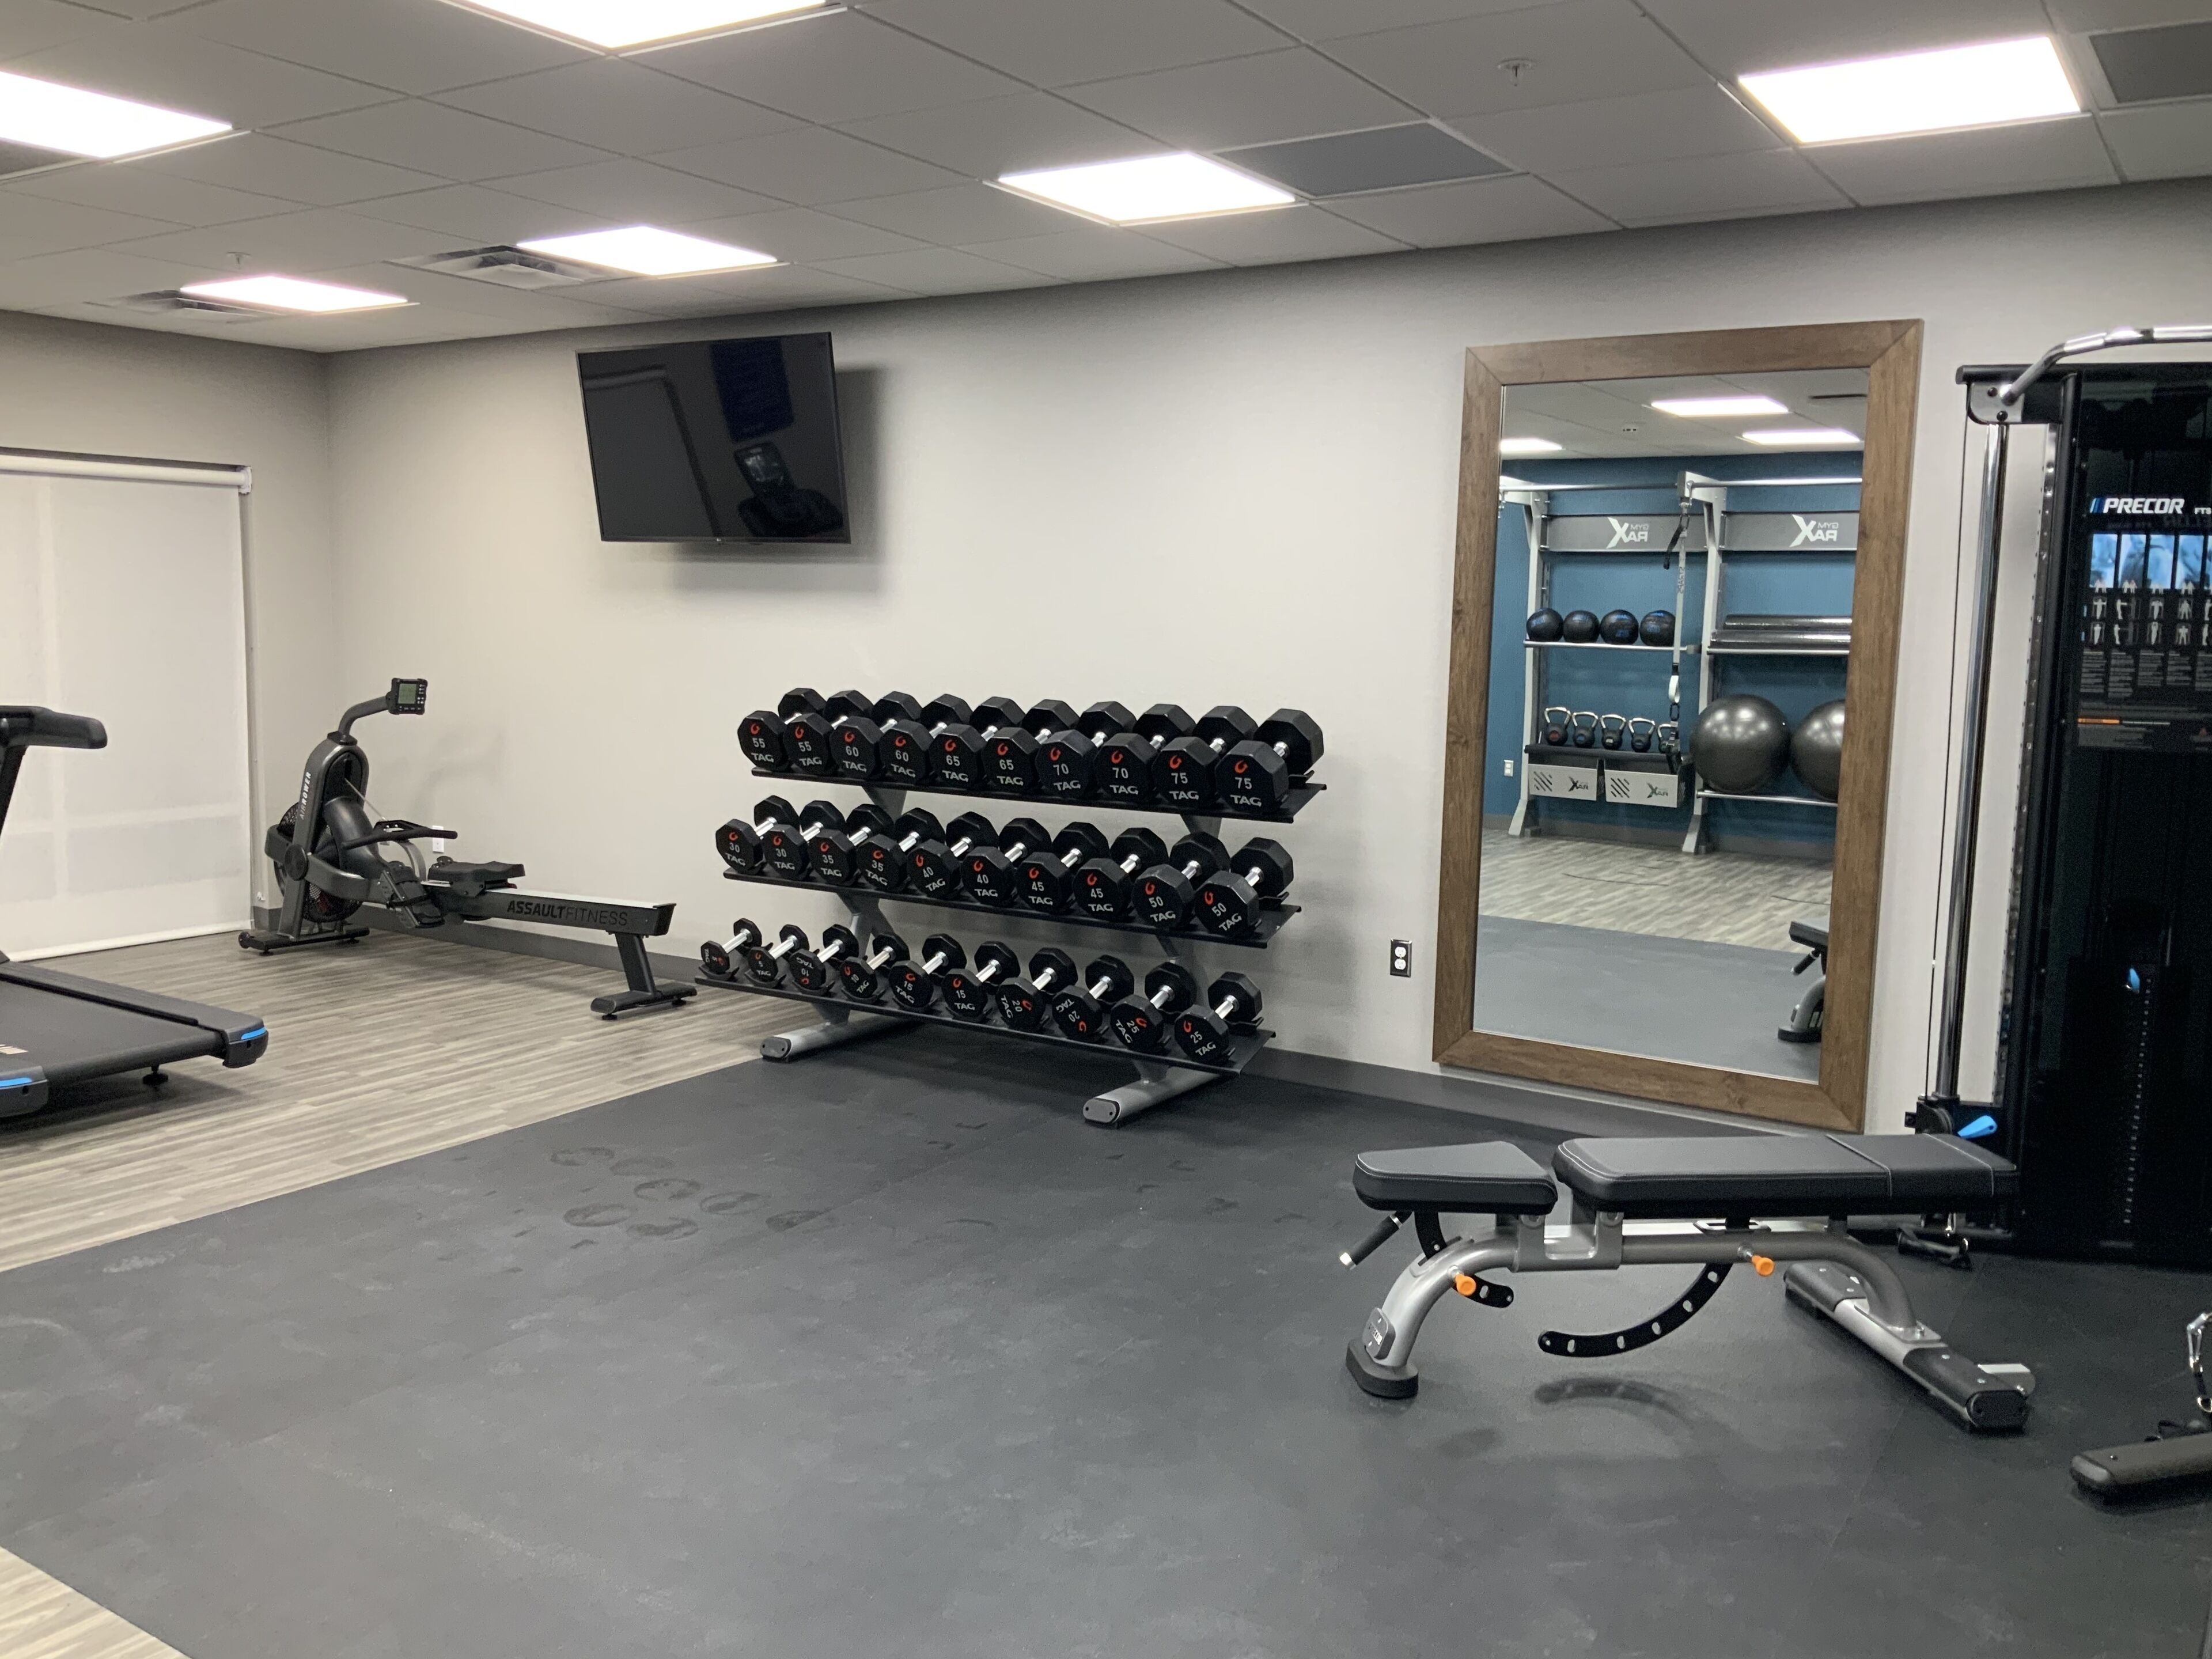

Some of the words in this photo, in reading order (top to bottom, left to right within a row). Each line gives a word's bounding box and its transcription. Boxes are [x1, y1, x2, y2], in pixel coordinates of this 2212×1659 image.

[2103, 498, 2185, 514] PRECOR
[752, 738, 766, 748] 55
[798, 741, 812, 752] 55
[846, 746, 858, 757] 60
[895, 750, 908, 762] 60
[751, 753, 774, 762] TAG
[799, 757, 822, 766] TAG
[946, 755, 960, 766] 65
[843, 760, 867, 772] TAG
[999, 759, 1014, 770] 65
[1053, 764, 1069, 775] 70
[891, 764, 916, 777] TAG
[942, 770, 969, 782] TAG
[1112, 768, 1128, 779] 70
[997, 776, 1024, 786] TAG
[1171, 772, 1188, 784] 75
[1235, 778, 1252, 789] 75
[1054, 781, 1081, 791] TAG
[1110, 785, 1138, 795] TAG
[1169, 791, 1199, 800] TAG
[1230, 795, 1262, 806] TAG
[729, 842, 740, 853] 30
[776, 849, 786, 857] 30
[725, 853, 746, 866] TAG
[822, 855, 834, 863] 35
[774, 862, 796, 870] TAG
[872, 860, 884, 872] 35
[821, 868, 842, 877] TAG
[866, 869, 888, 886] TAG
[923, 866, 934, 878] 40
[977, 874, 988, 884] 40
[926, 878, 946, 892] TAG
[1032, 881, 1044, 891] 45
[975, 889, 998, 897] TAG
[1090, 888, 1103, 898] 45
[1028, 896, 1053, 905] TAG
[1149, 896, 1163, 908] 50
[1088, 904, 1113, 912] TAG
[1212, 903, 1226, 916] 50
[1150, 911, 1176, 922] TAG
[1219, 913, 1242, 931] TAG
[796, 957, 813, 968] TAG
[857, 980, 869, 993] TAG
[904, 981, 913, 990] 15
[895, 986, 915, 1003] TAG
[956, 990, 966, 999] 15
[1001, 995, 1013, 1018] TAG
[1012, 1000, 1022, 1012] 20
[1056, 999, 1074, 1012] TAG
[1069, 1011, 1080, 1022] 20
[1115, 1020, 1132, 1043] TAG
[1127, 1020, 1139, 1033] 25
[1190, 1031, 1202, 1044] 25
[1195, 1041, 1216, 1056] TAG
